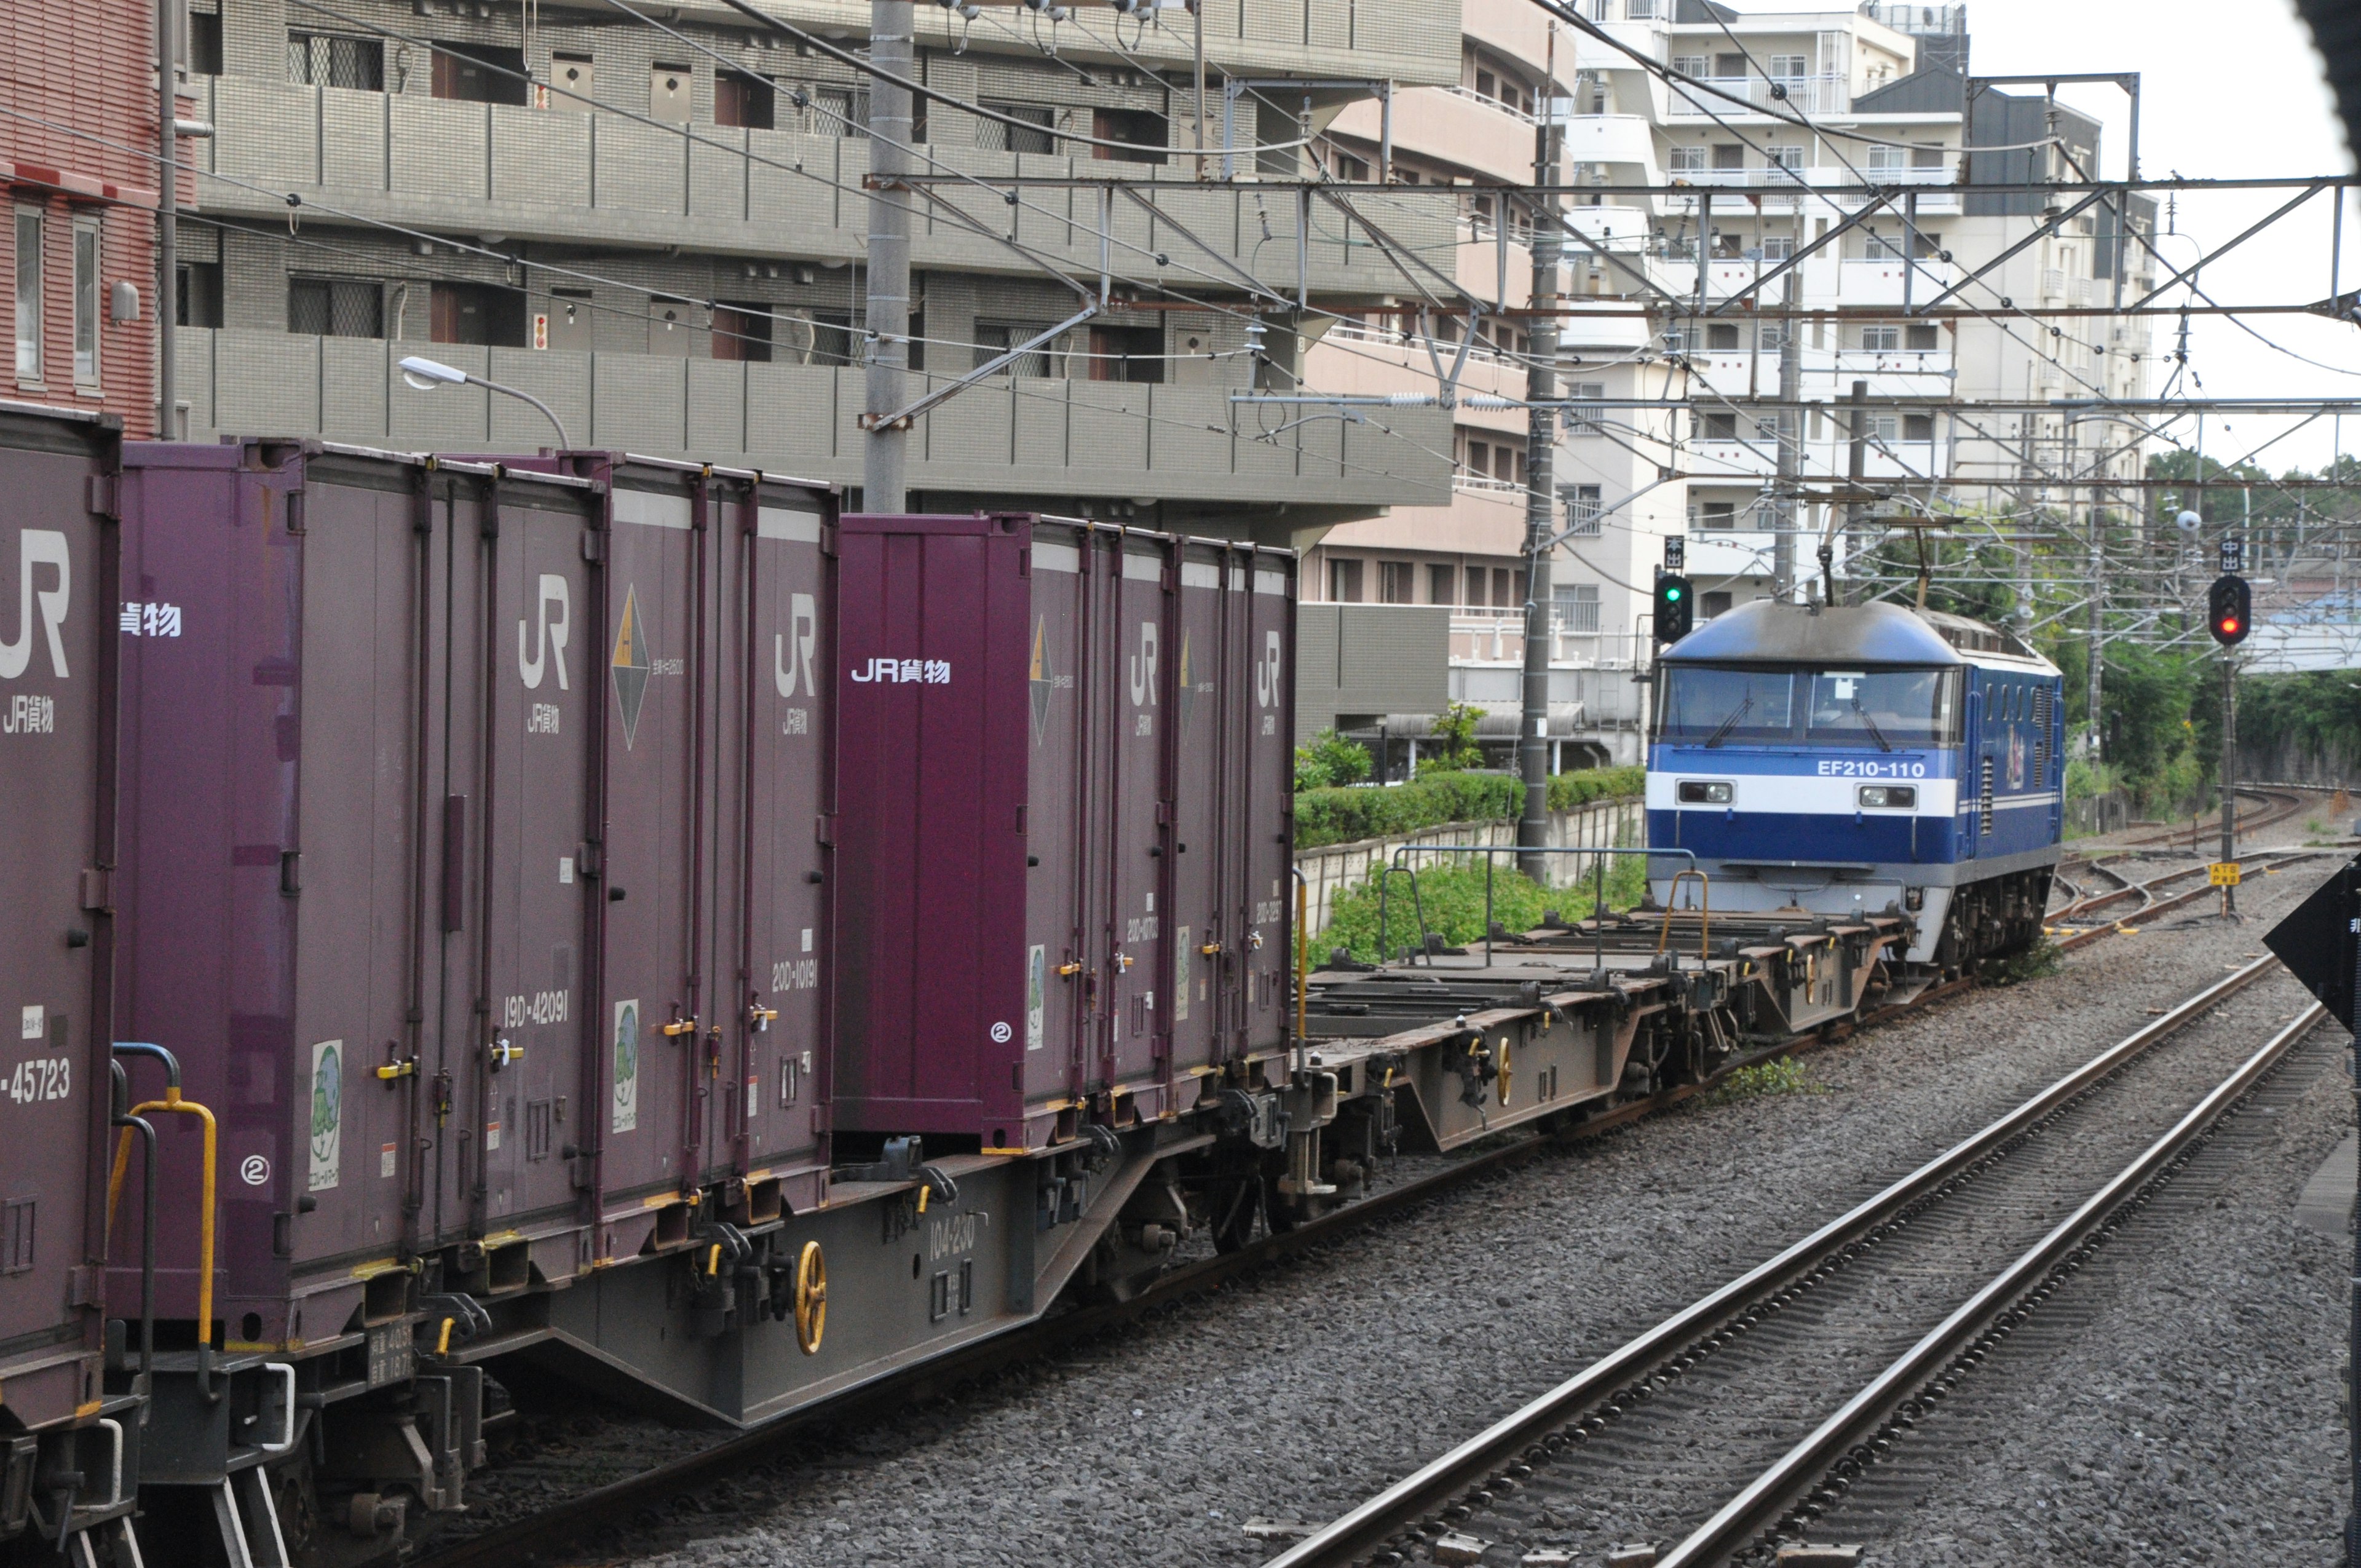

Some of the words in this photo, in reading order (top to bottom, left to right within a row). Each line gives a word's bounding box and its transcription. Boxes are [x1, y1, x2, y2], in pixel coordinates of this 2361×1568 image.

[1667, 537, 1682, 566] 本出
[2221, 540, 2239, 570] 中出
[518, 574, 569, 690] JR
[775, 593, 816, 697] JR
[851, 658, 951, 684] JR貨物
[1131, 622, 1157, 707] JR
[1258, 630, 1280, 708] JR
[4, 695, 54, 734] JR貨物
[528, 703, 560, 734] JR貨物
[782, 708, 807, 735] JR貨物
[1817, 761, 1925, 778] EF210-110
[772, 958, 818, 992] 20D-10191
[504, 989, 568, 1028] 19D-42091
